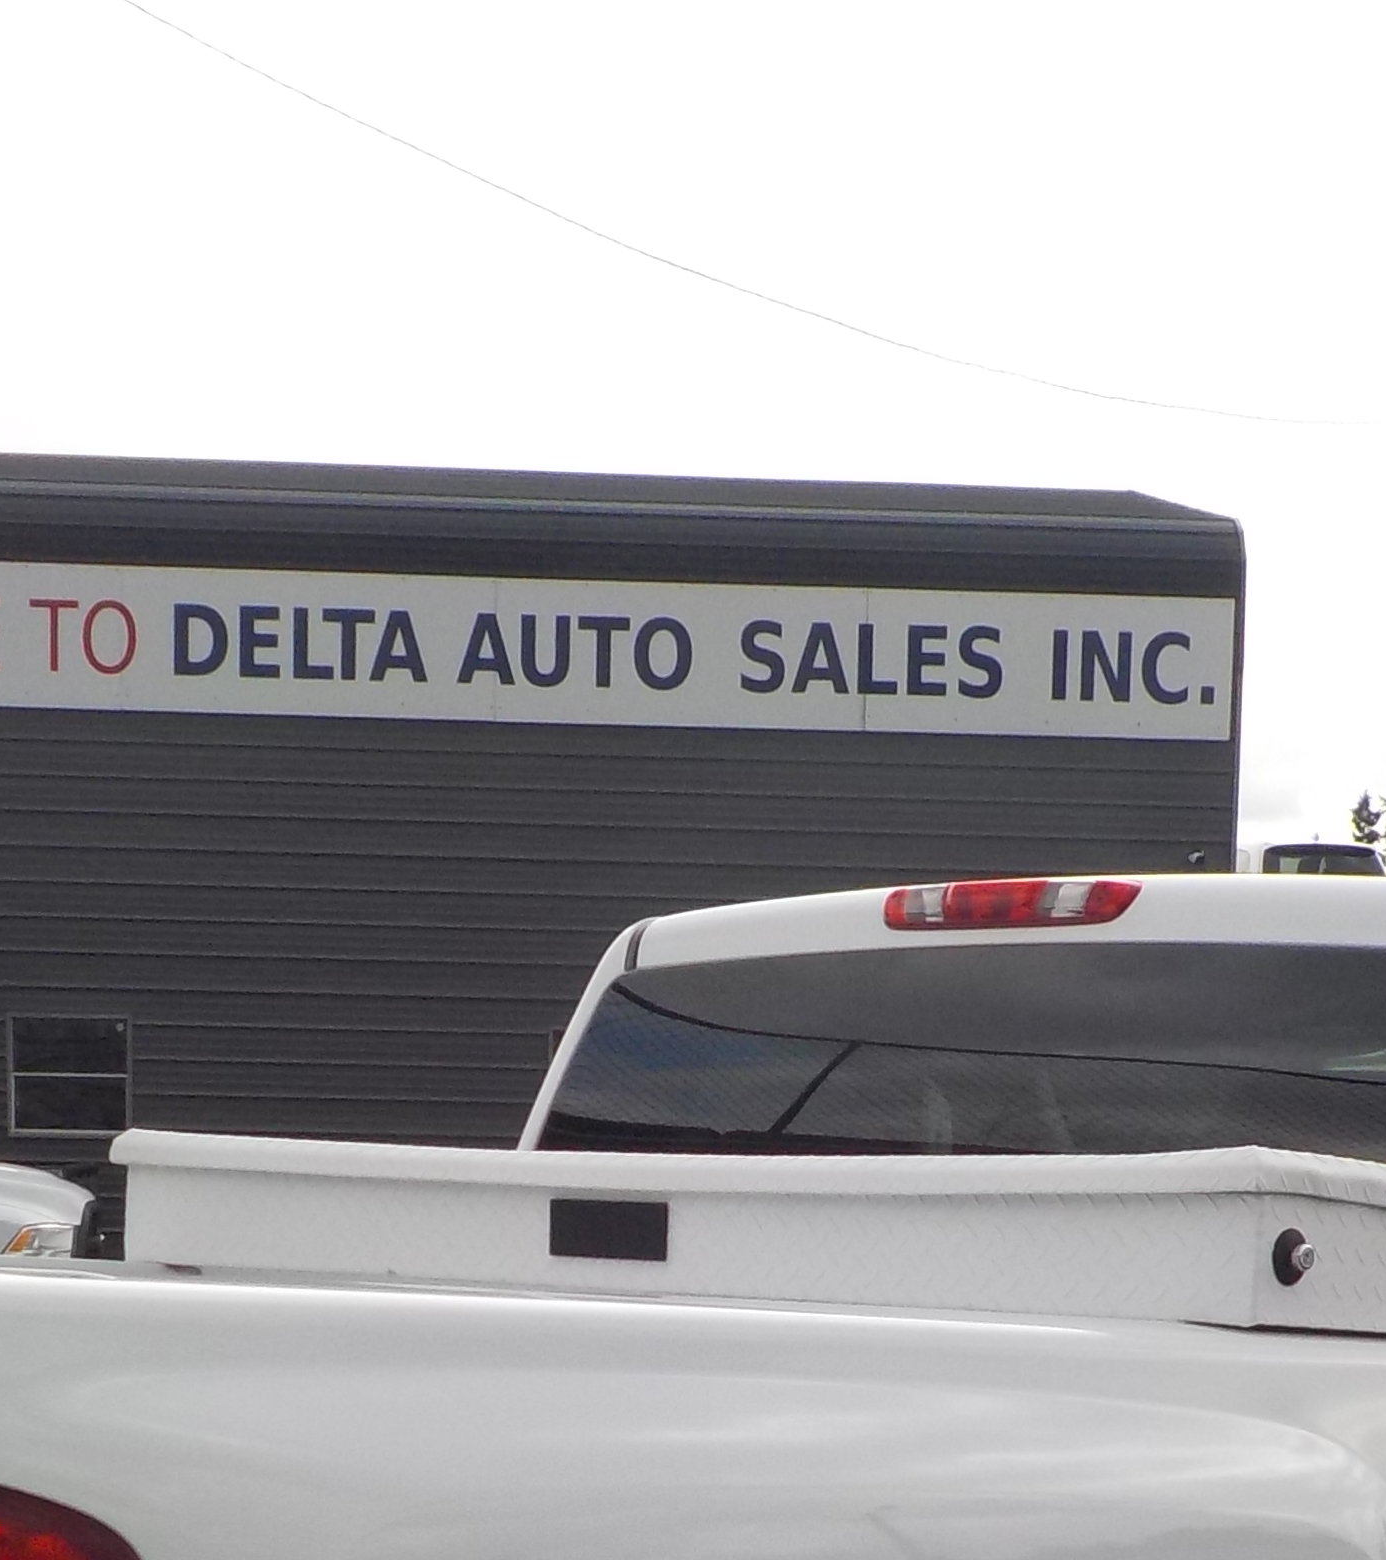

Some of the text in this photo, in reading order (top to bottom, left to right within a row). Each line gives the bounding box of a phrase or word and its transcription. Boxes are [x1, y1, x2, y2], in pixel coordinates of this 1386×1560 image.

[29, 599, 138, 675] TO
[172, 603, 428, 683] DELTA
[457, 613, 694, 691] AUTO
[739, 620, 1004, 699] SALES
[1050, 629, 1217, 705] INC.
